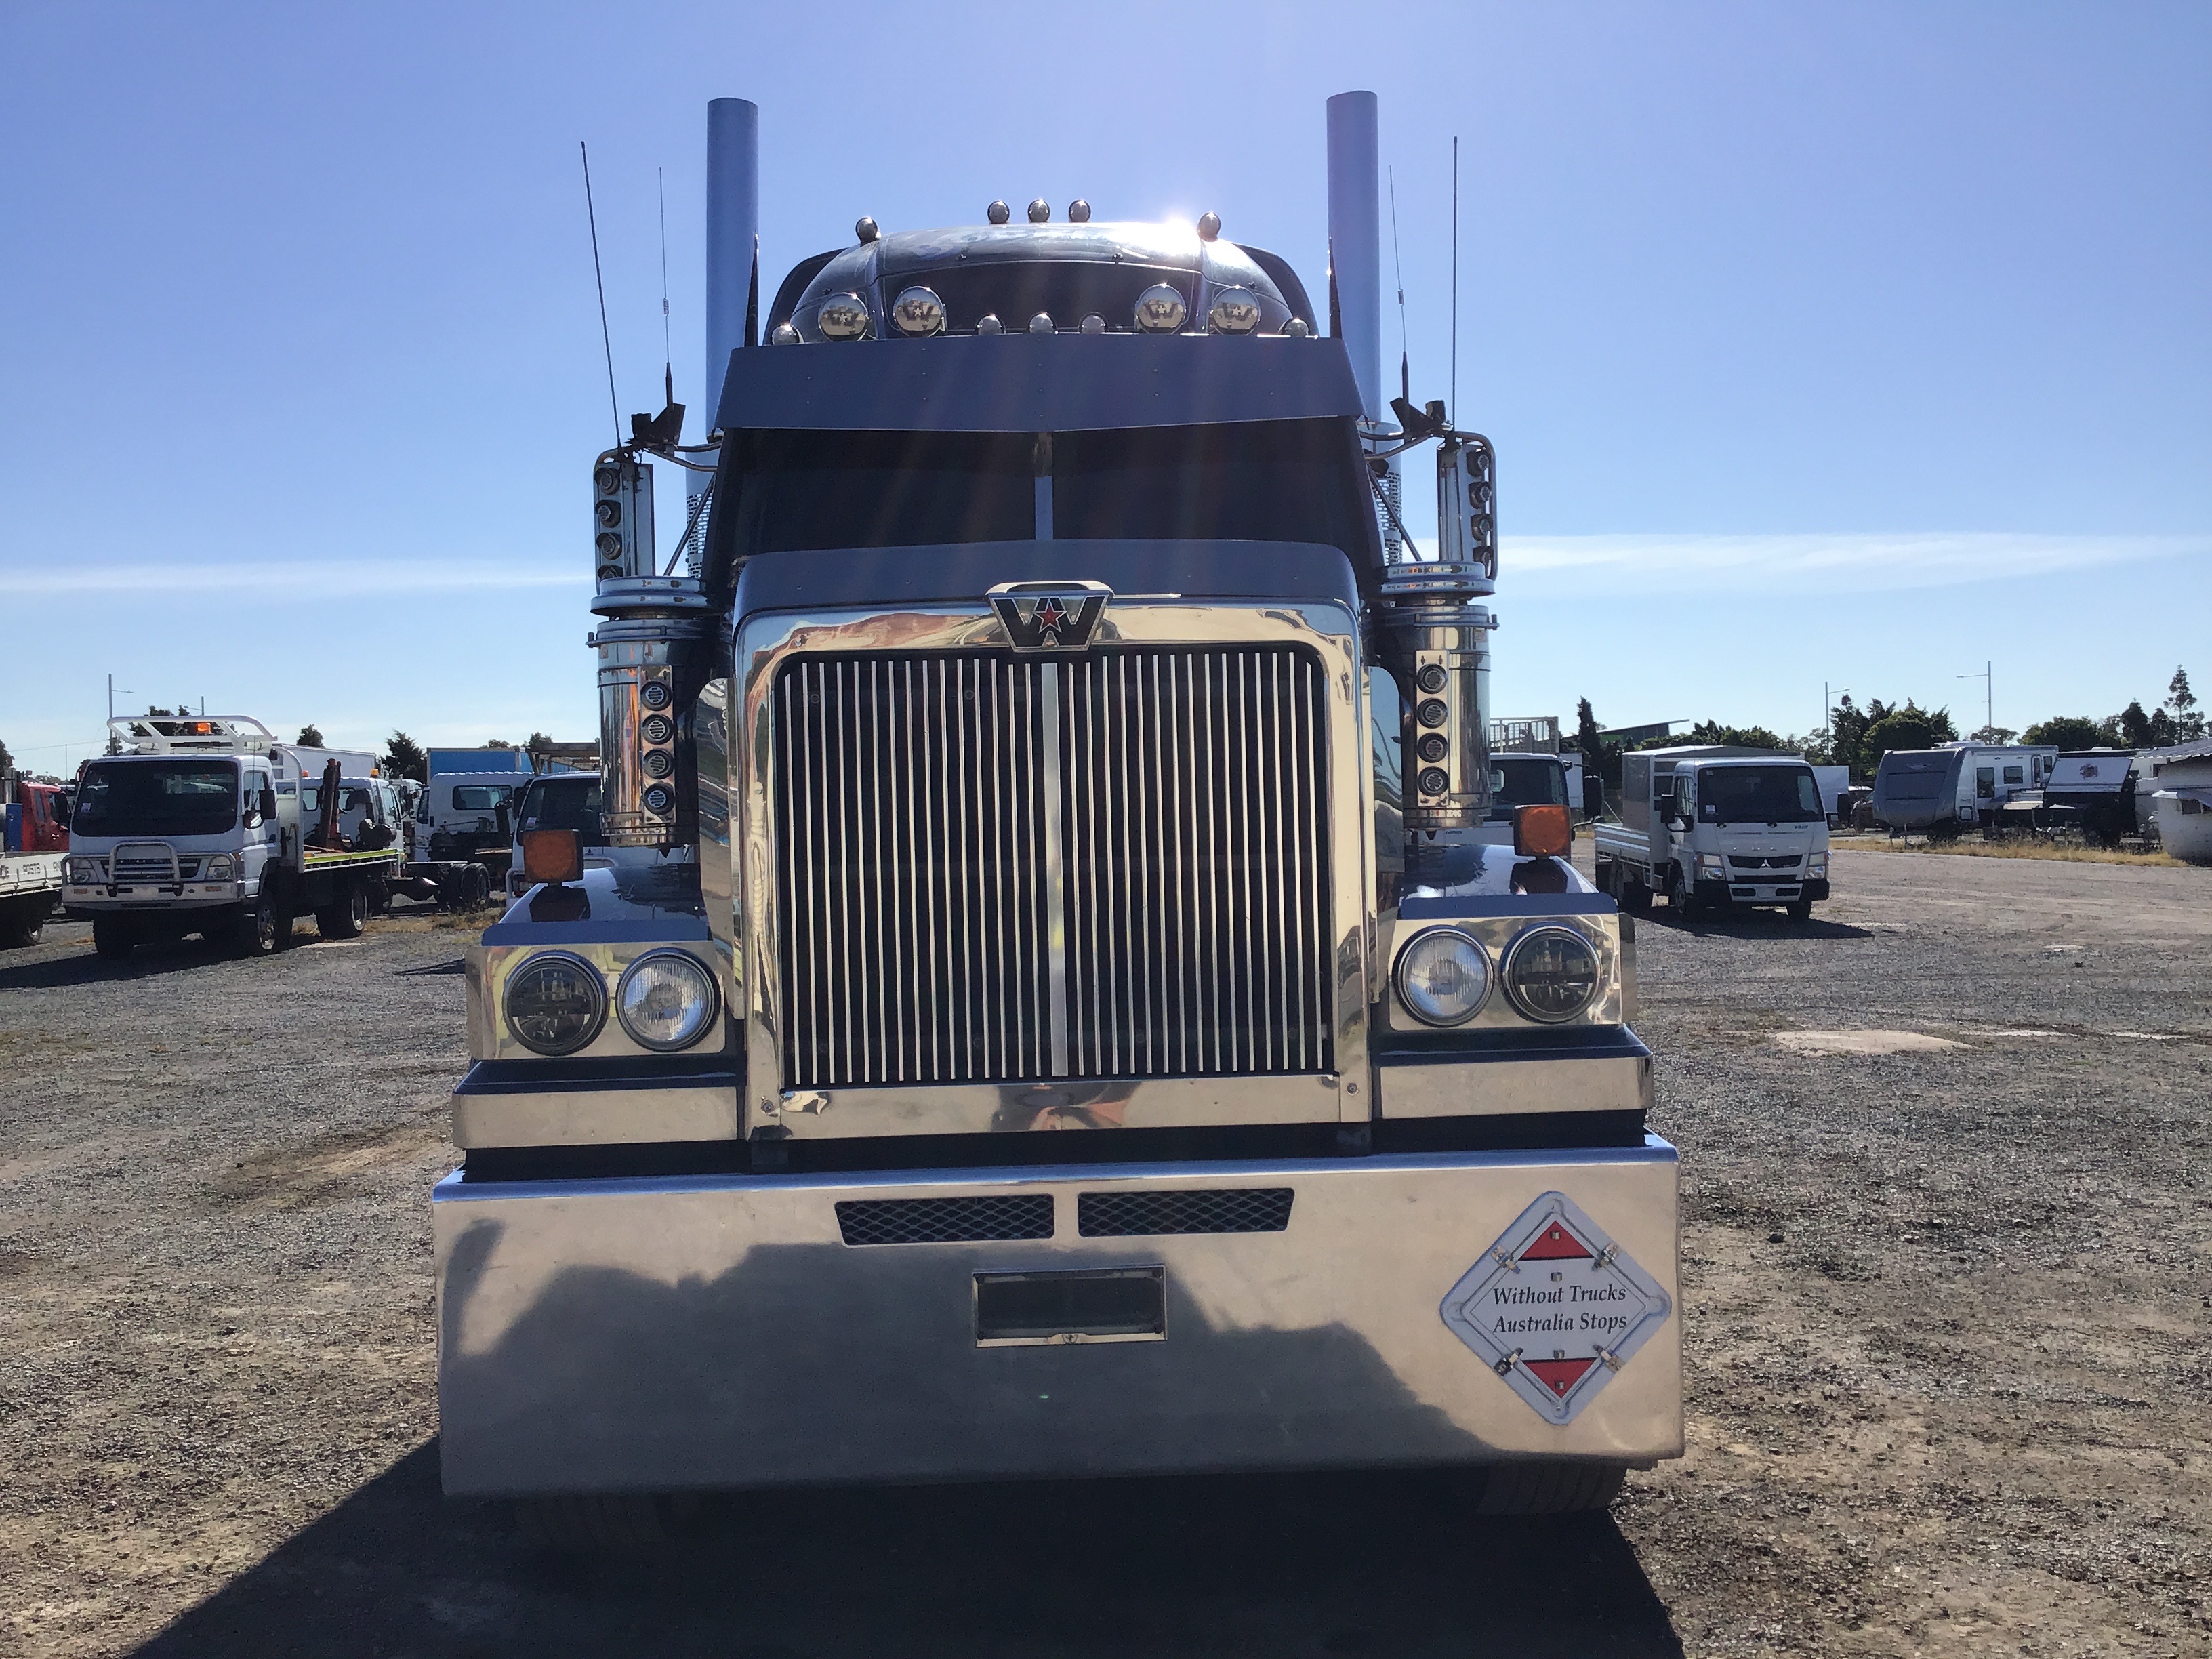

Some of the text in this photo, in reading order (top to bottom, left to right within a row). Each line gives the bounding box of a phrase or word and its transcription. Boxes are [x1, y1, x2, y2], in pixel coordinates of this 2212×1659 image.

[1493, 1283, 1626, 1305] Without Trucks
[1492, 1312, 1626, 1334] Australia Stops
